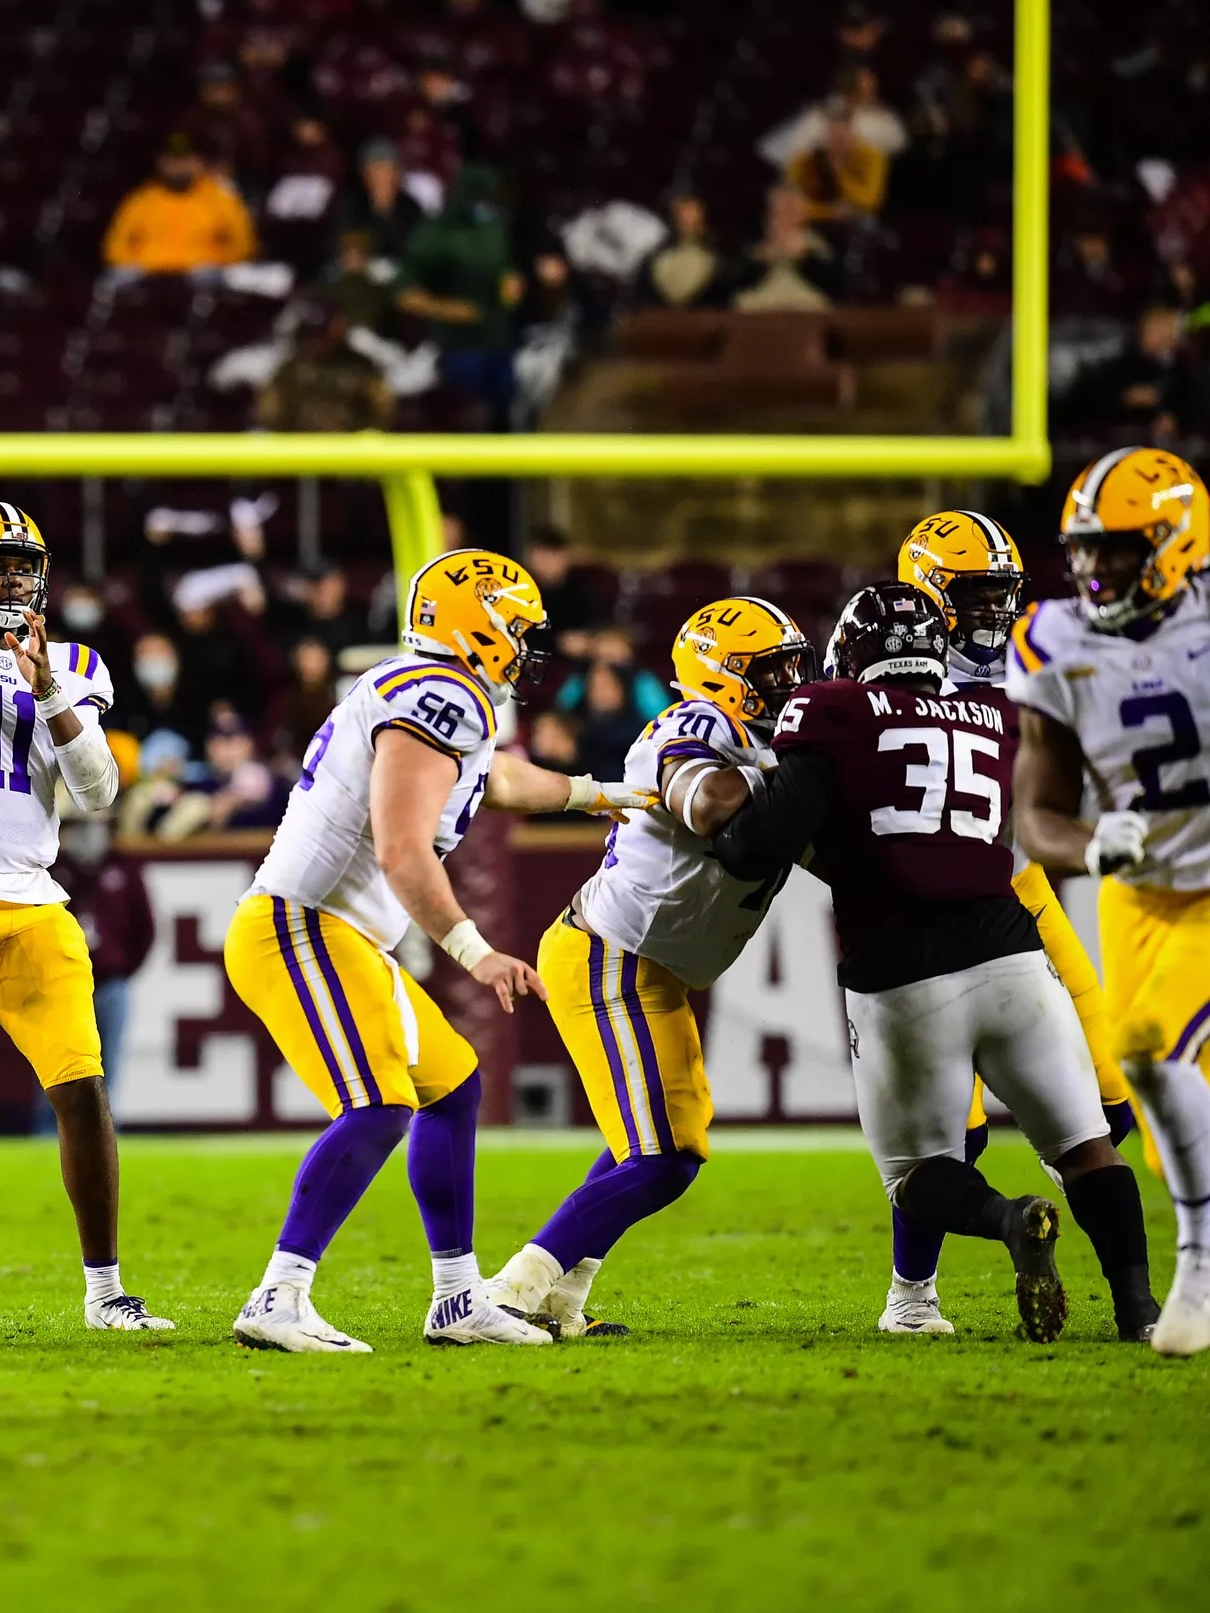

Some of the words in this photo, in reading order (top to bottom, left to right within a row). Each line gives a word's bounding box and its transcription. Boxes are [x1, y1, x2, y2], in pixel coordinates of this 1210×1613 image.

[888, 660, 913, 669] TEXAS
[412, 691, 465, 740] 56
[677, 712, 717, 743] 70
[867, 691, 903, 717] M.
[915, 697, 1004, 736] JACKSON
[869, 726, 1002, 845] 35
[430, 1288, 474, 1330] NIKE
